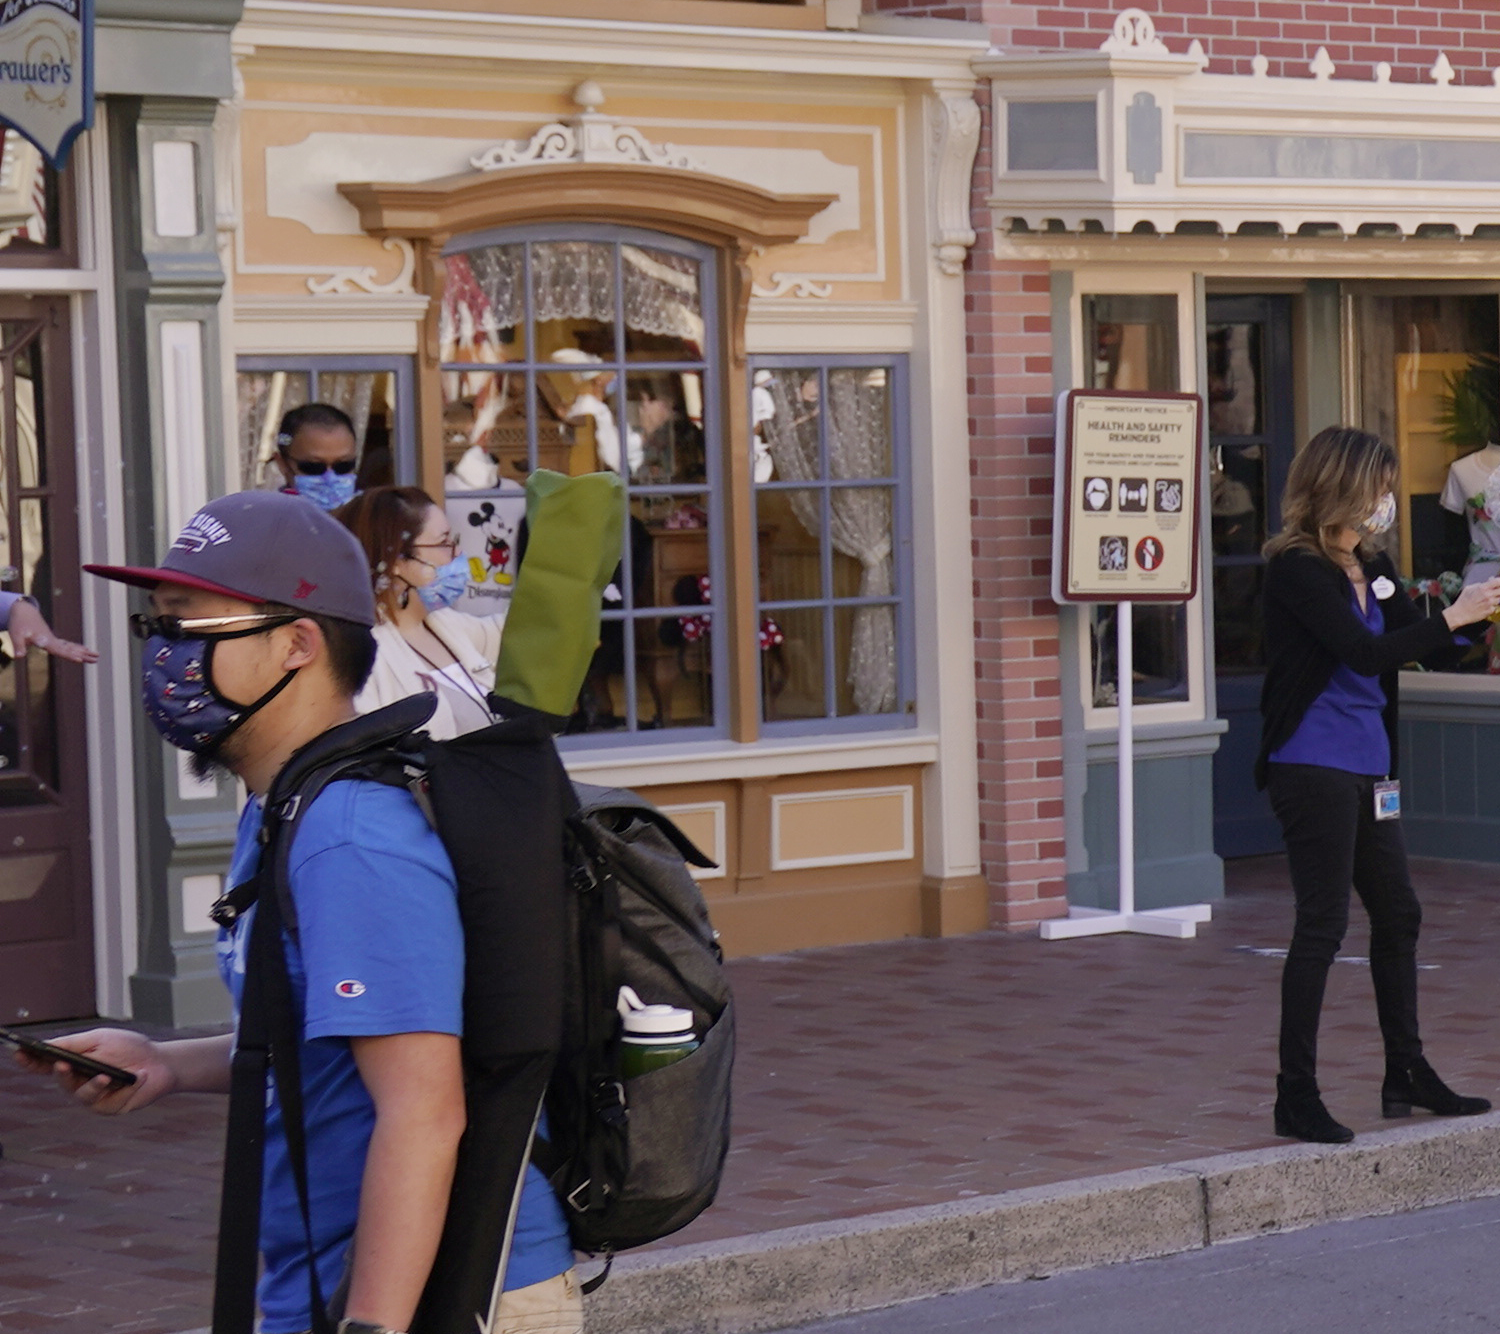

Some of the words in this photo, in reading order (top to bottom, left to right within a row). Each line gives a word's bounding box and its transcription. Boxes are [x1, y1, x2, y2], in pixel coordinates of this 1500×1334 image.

[1088, 421, 1124, 431] HEALTH
[1126, 422, 1147, 432] AND
[1148, 423, 1182, 433] SAFETY
[1109, 433, 1161, 444] REMINDERS
